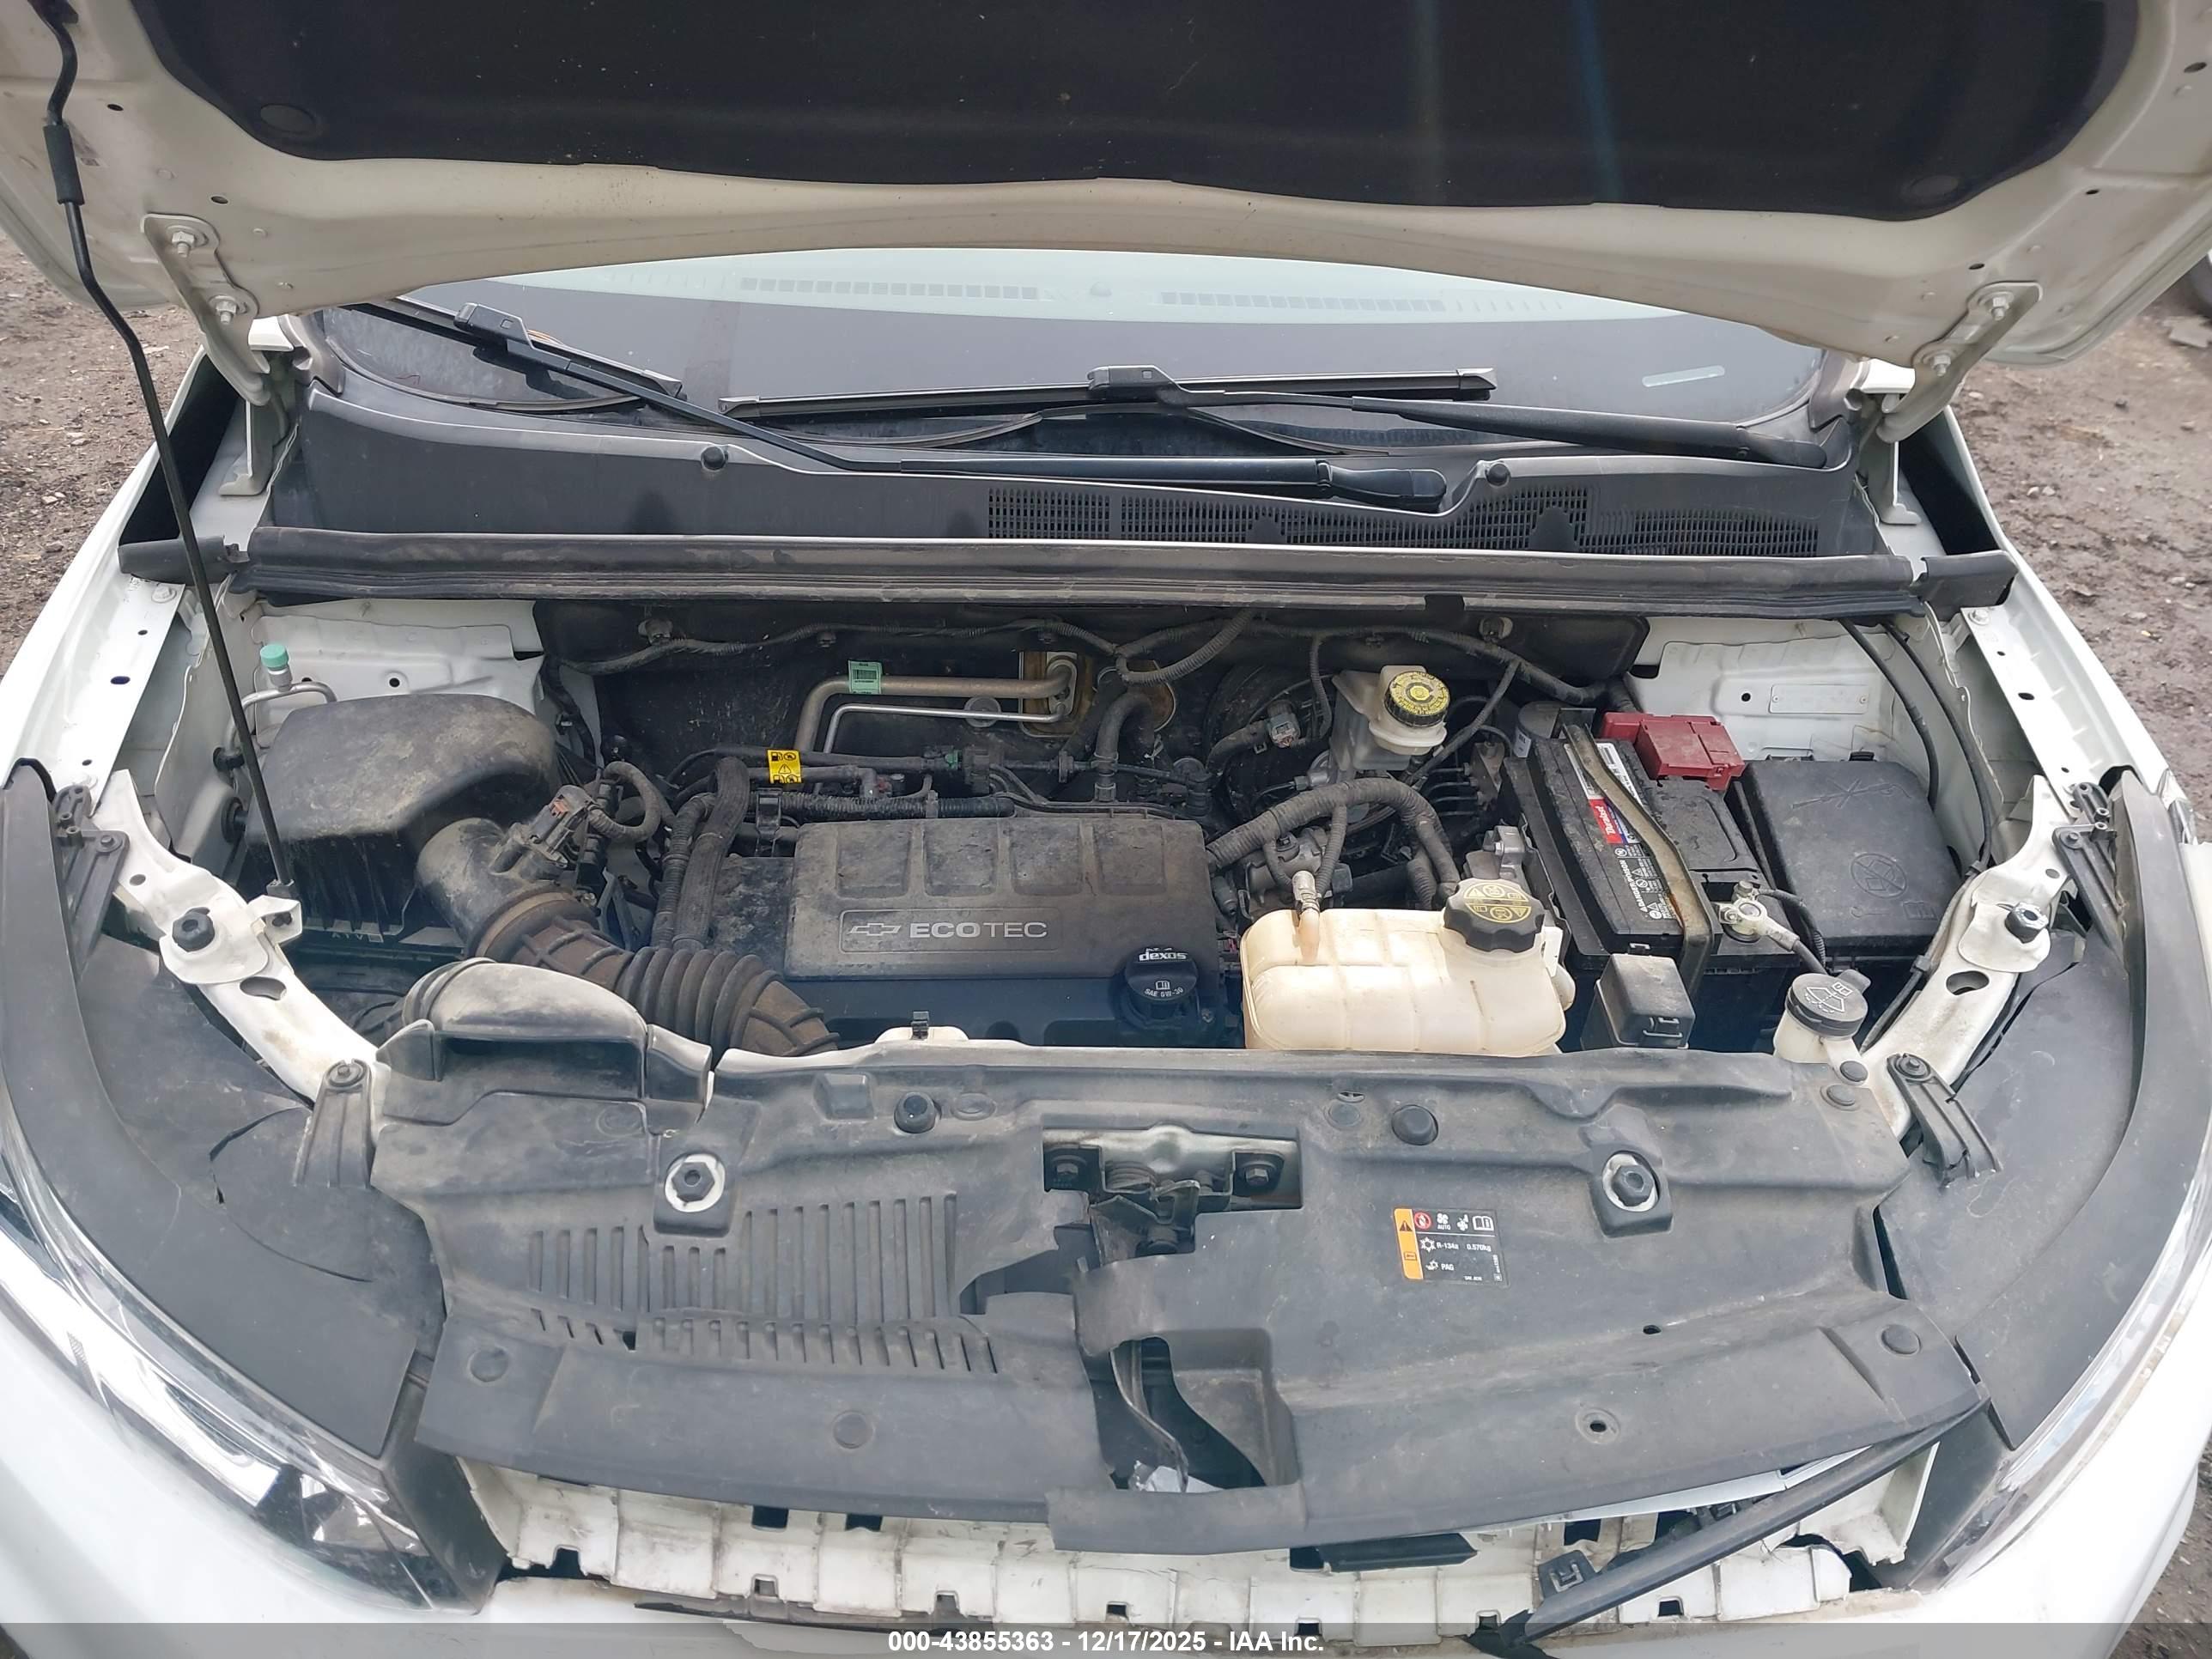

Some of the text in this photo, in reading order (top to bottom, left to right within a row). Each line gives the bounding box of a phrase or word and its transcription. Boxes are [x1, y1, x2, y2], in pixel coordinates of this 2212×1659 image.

[909, 921, 1048, 939] ECOTEC
[1139, 950, 1188, 961] dexos
[1144, 988, 1158, 997] SAE
